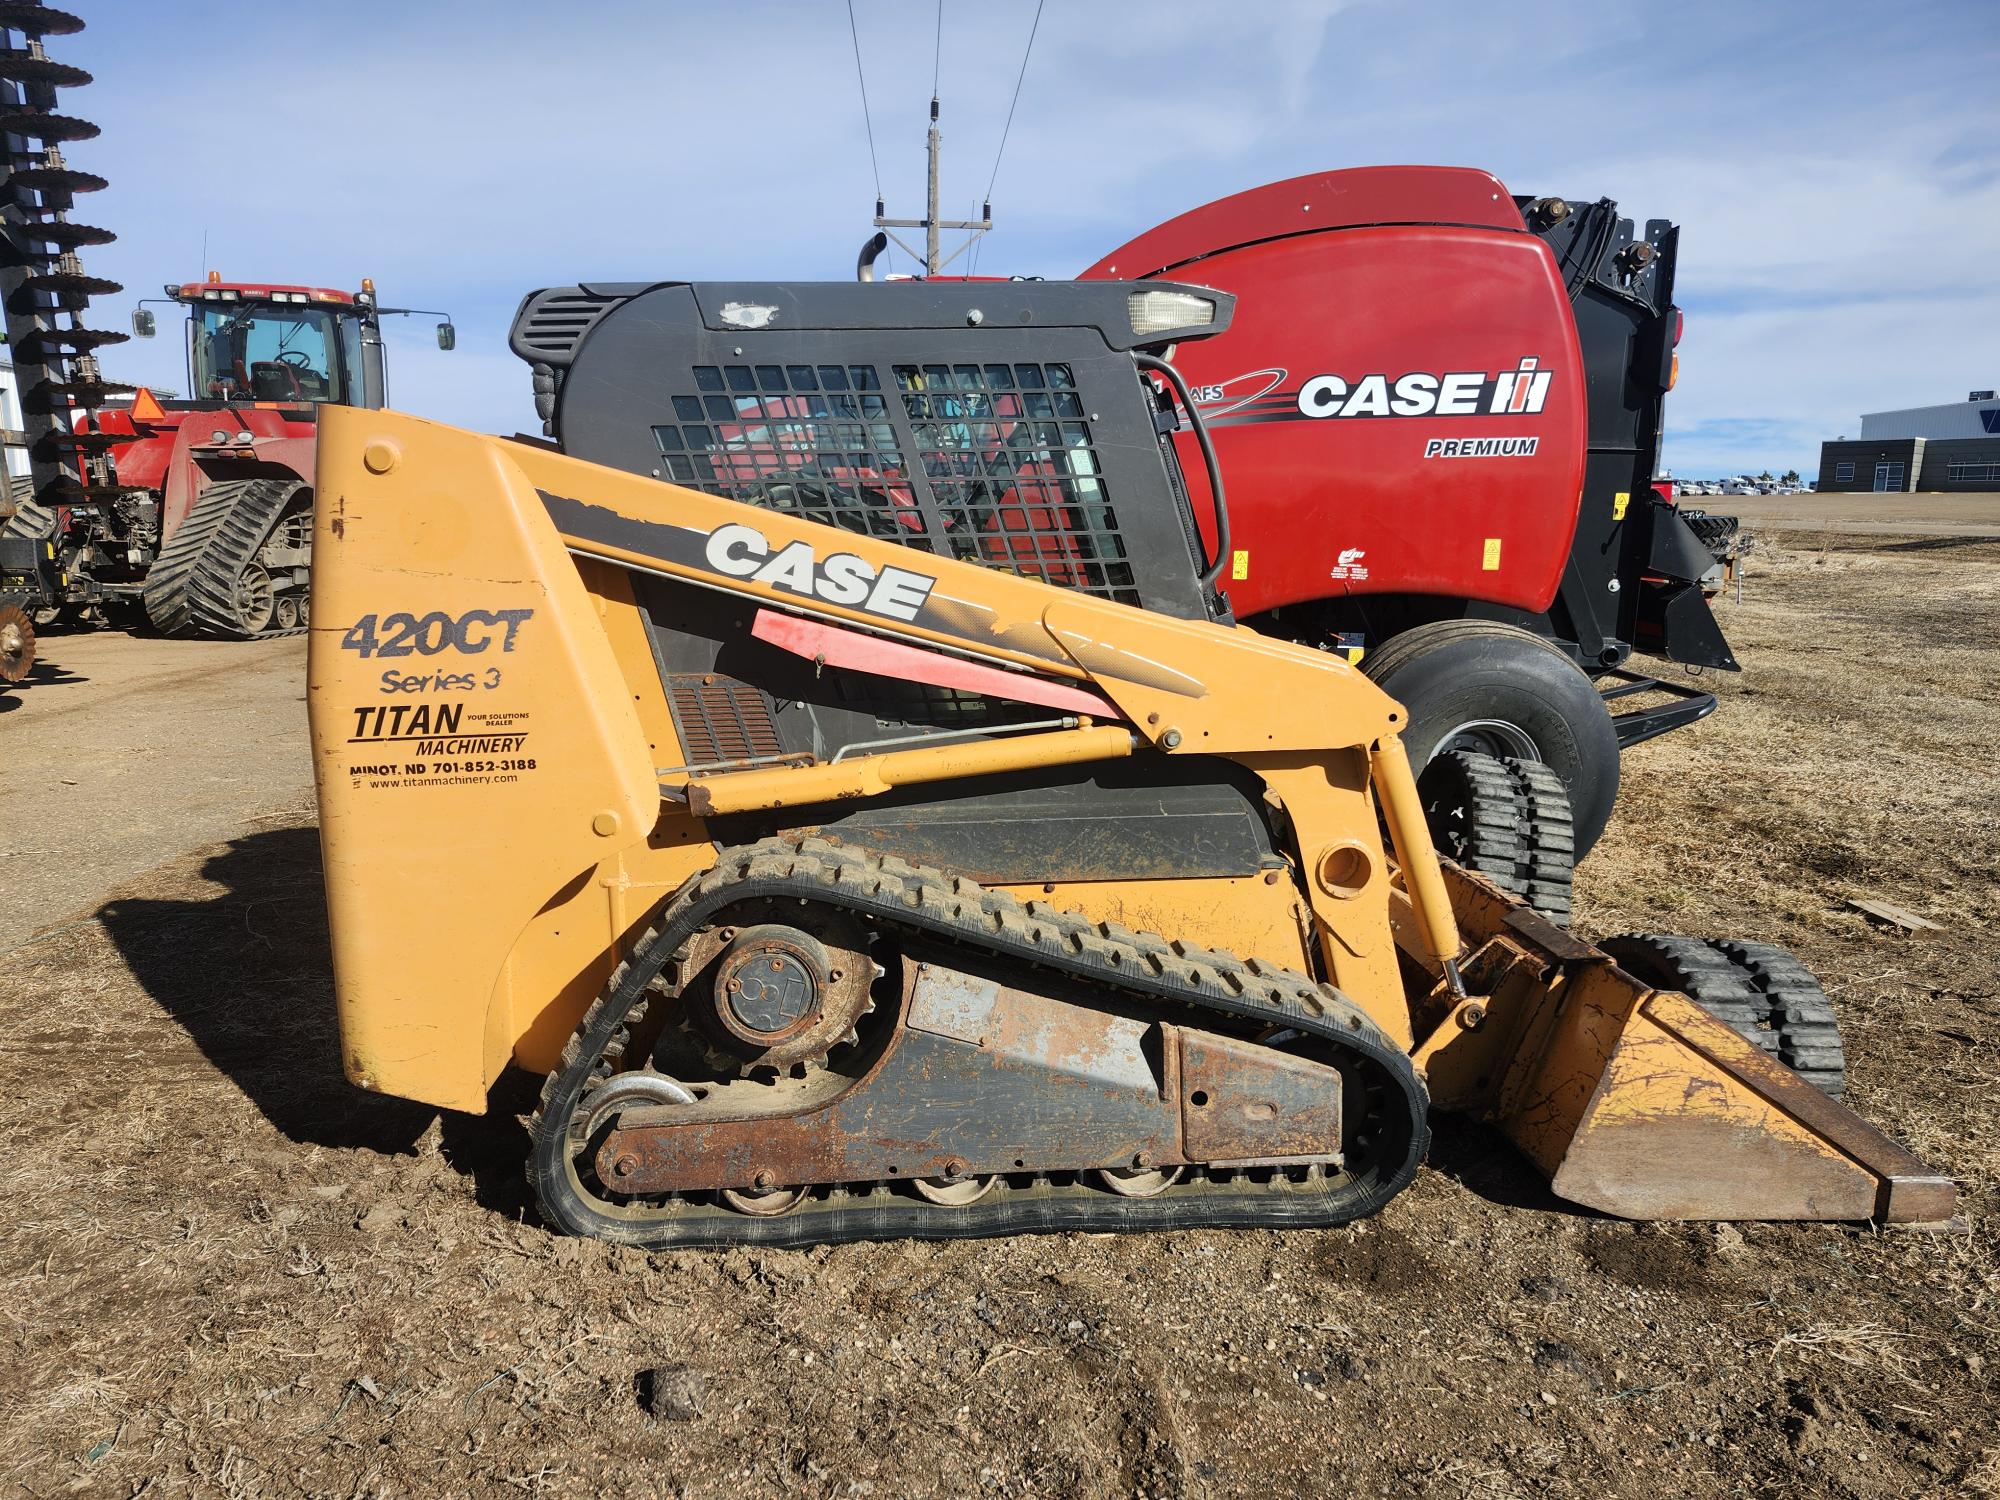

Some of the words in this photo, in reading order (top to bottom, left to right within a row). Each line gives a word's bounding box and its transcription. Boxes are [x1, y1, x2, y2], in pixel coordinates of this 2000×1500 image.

[1297, 374, 1488, 418] CASE
[1424, 438, 1539, 458] PREMIUM
[705, 523, 936, 621] CASE
[341, 609, 534, 658] 420CT
[380, 669, 476, 693] Series
[484, 667, 502, 689] 3
[354, 703, 463, 737] TITAN
[467, 713, 487, 721] YOUR
[489, 712, 530, 720] SOLUTIONS
[416, 737, 526, 756] MACHINERY
[405, 763, 426, 775] ND
[433, 759, 537, 774] 701-852-3188
[370, 774, 518, 789] www.titanmachinery.com
